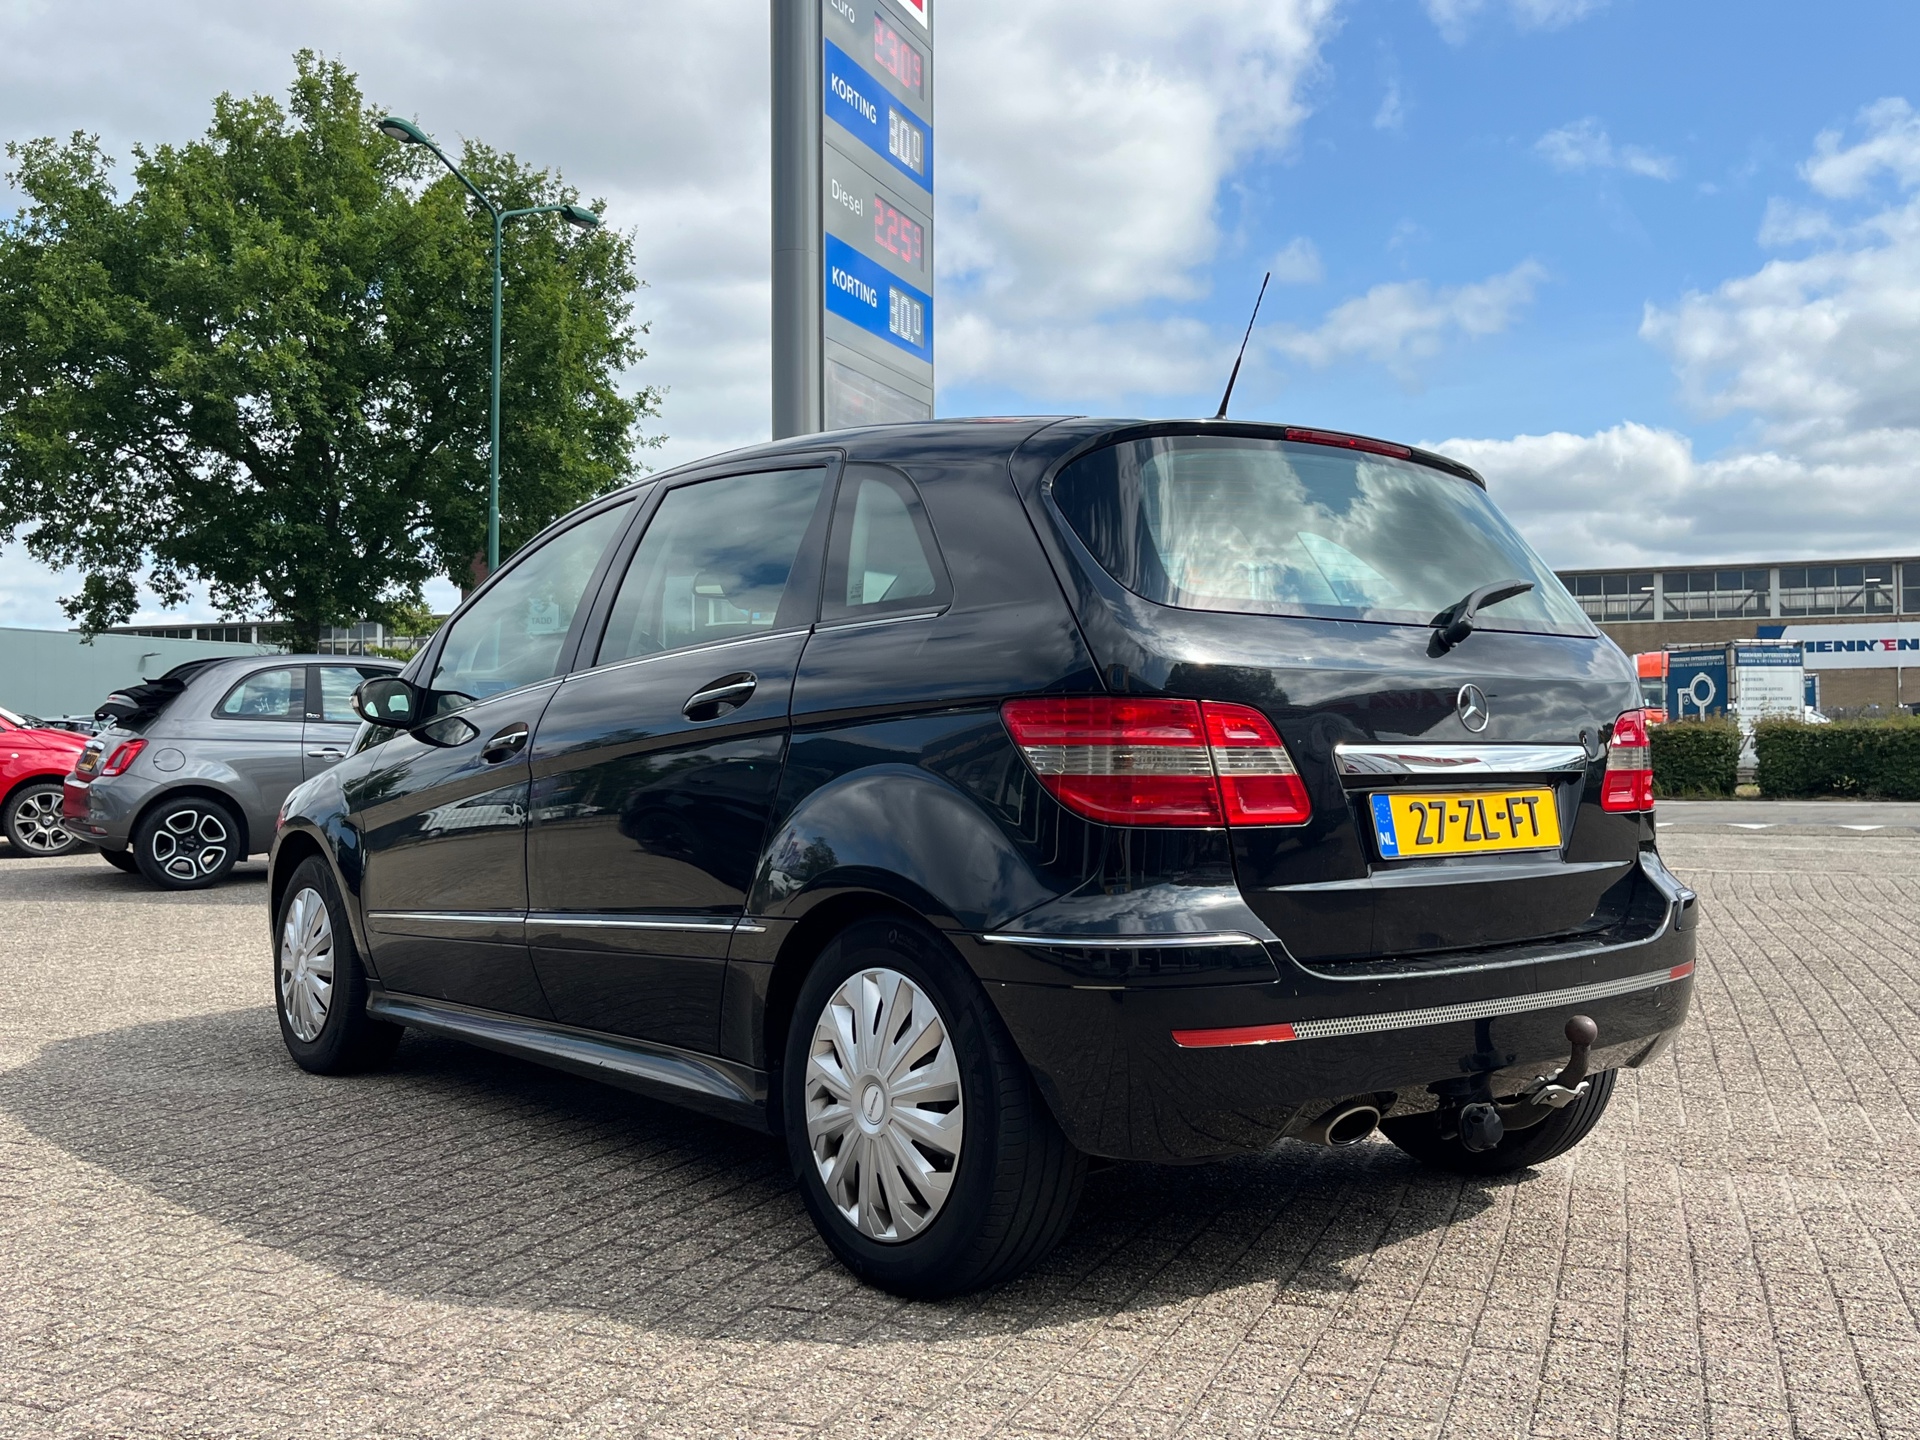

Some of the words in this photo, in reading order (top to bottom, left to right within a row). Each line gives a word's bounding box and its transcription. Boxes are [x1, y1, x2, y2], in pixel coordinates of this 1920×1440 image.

[831, 73, 877, 125] KORTING
[831, 178, 863, 217] Diesel
[831, 266, 878, 309] KORTING
[1380, 832, 1395, 846] NL
[1409, 796, 1540, 846] 27-ZL-FT
